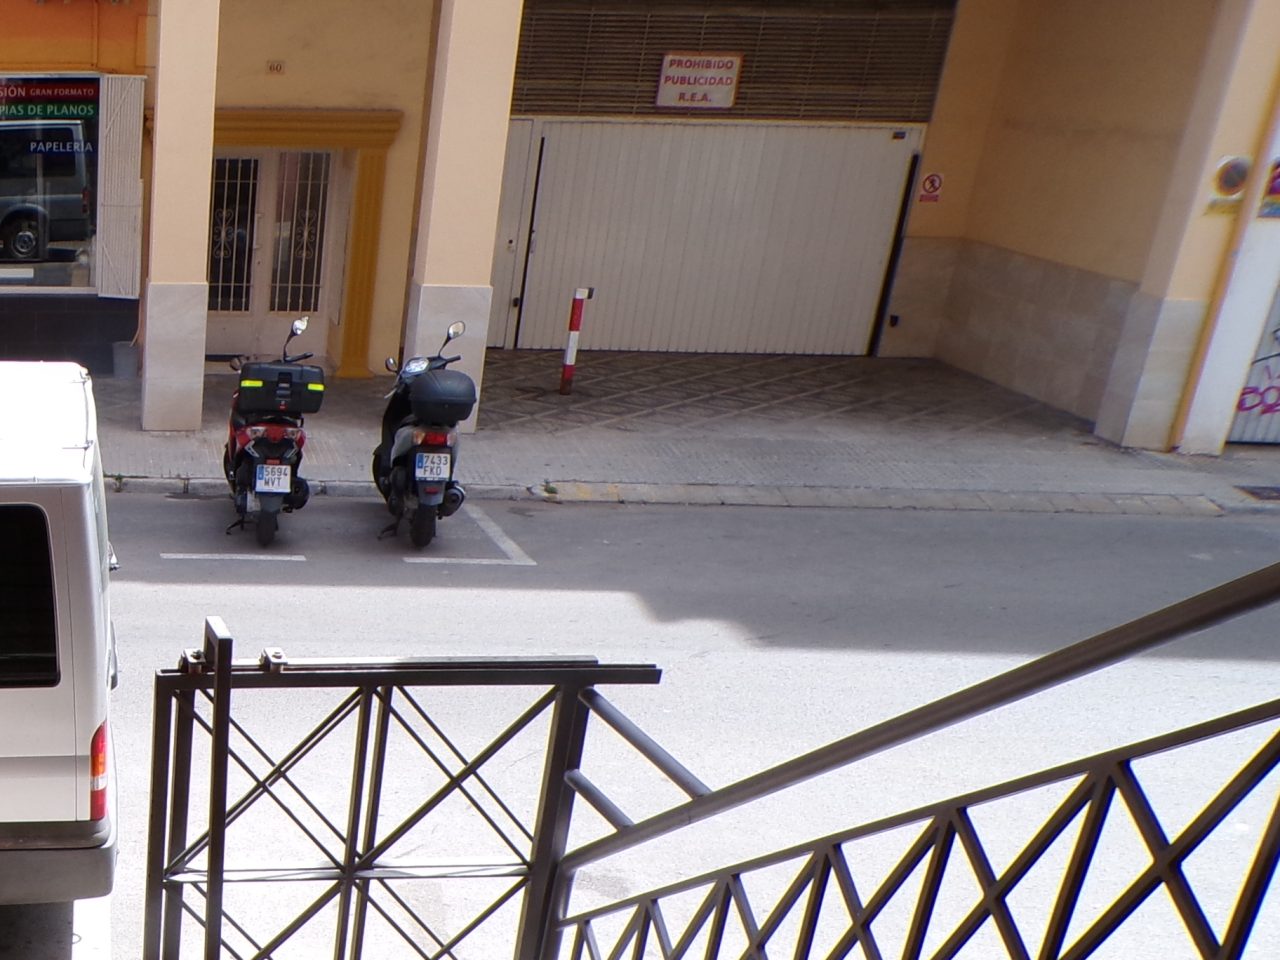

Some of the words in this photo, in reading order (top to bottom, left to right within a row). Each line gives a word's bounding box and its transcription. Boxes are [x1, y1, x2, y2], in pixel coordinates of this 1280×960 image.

[669, 59, 734, 69] PROHIBIDO
[664, 75, 733, 86] PUBLICIDAD
[29, 87, 52, 97] GRAN
[54, 87, 94, 97] FORMATO
[27, 104, 44, 115] DE
[46, 104, 94, 116] PLANOS
[424, 455, 449, 466] 7433
[264, 466, 288, 477] 5694
[263, 477, 282, 487] MVT
